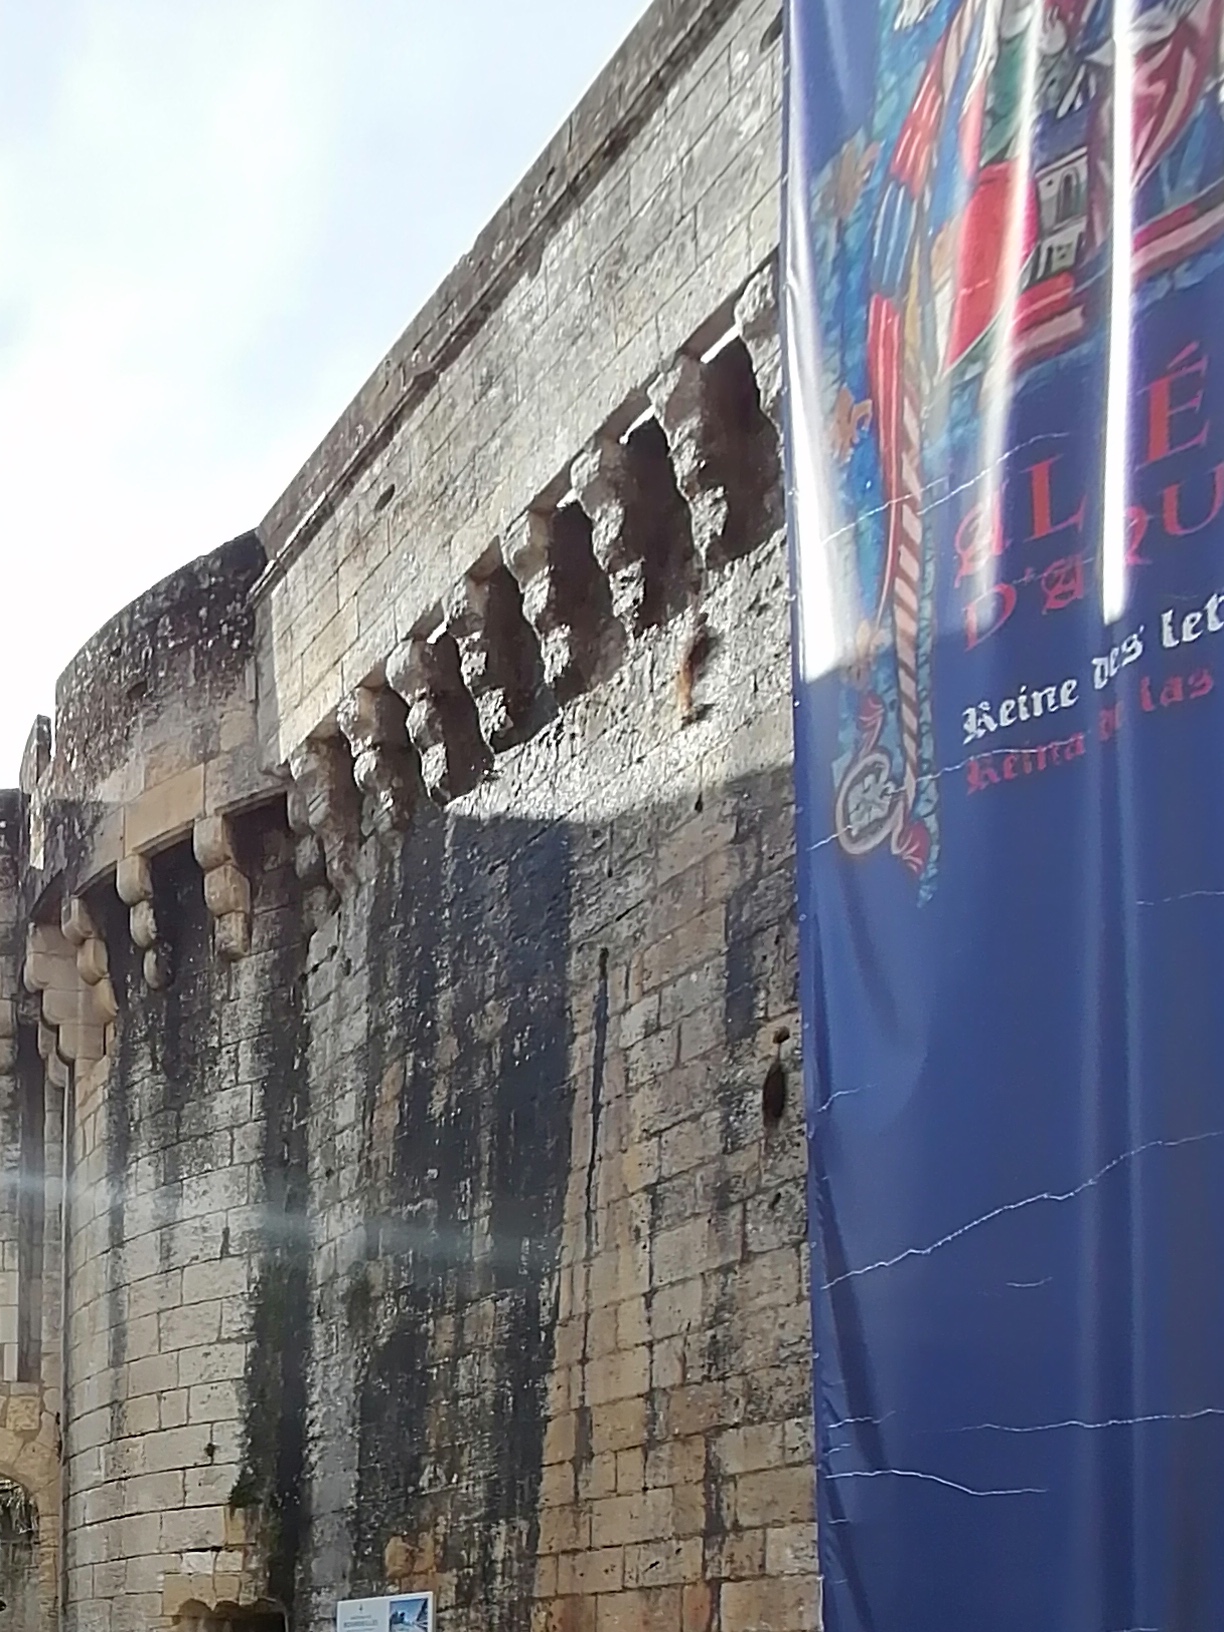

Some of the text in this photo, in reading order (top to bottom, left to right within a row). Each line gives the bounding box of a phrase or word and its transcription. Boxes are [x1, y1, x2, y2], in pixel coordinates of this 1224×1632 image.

[962, 684, 1079, 745] Reine
[1091, 624, 1145, 690] des
[1139, 669, 1214, 713] las
